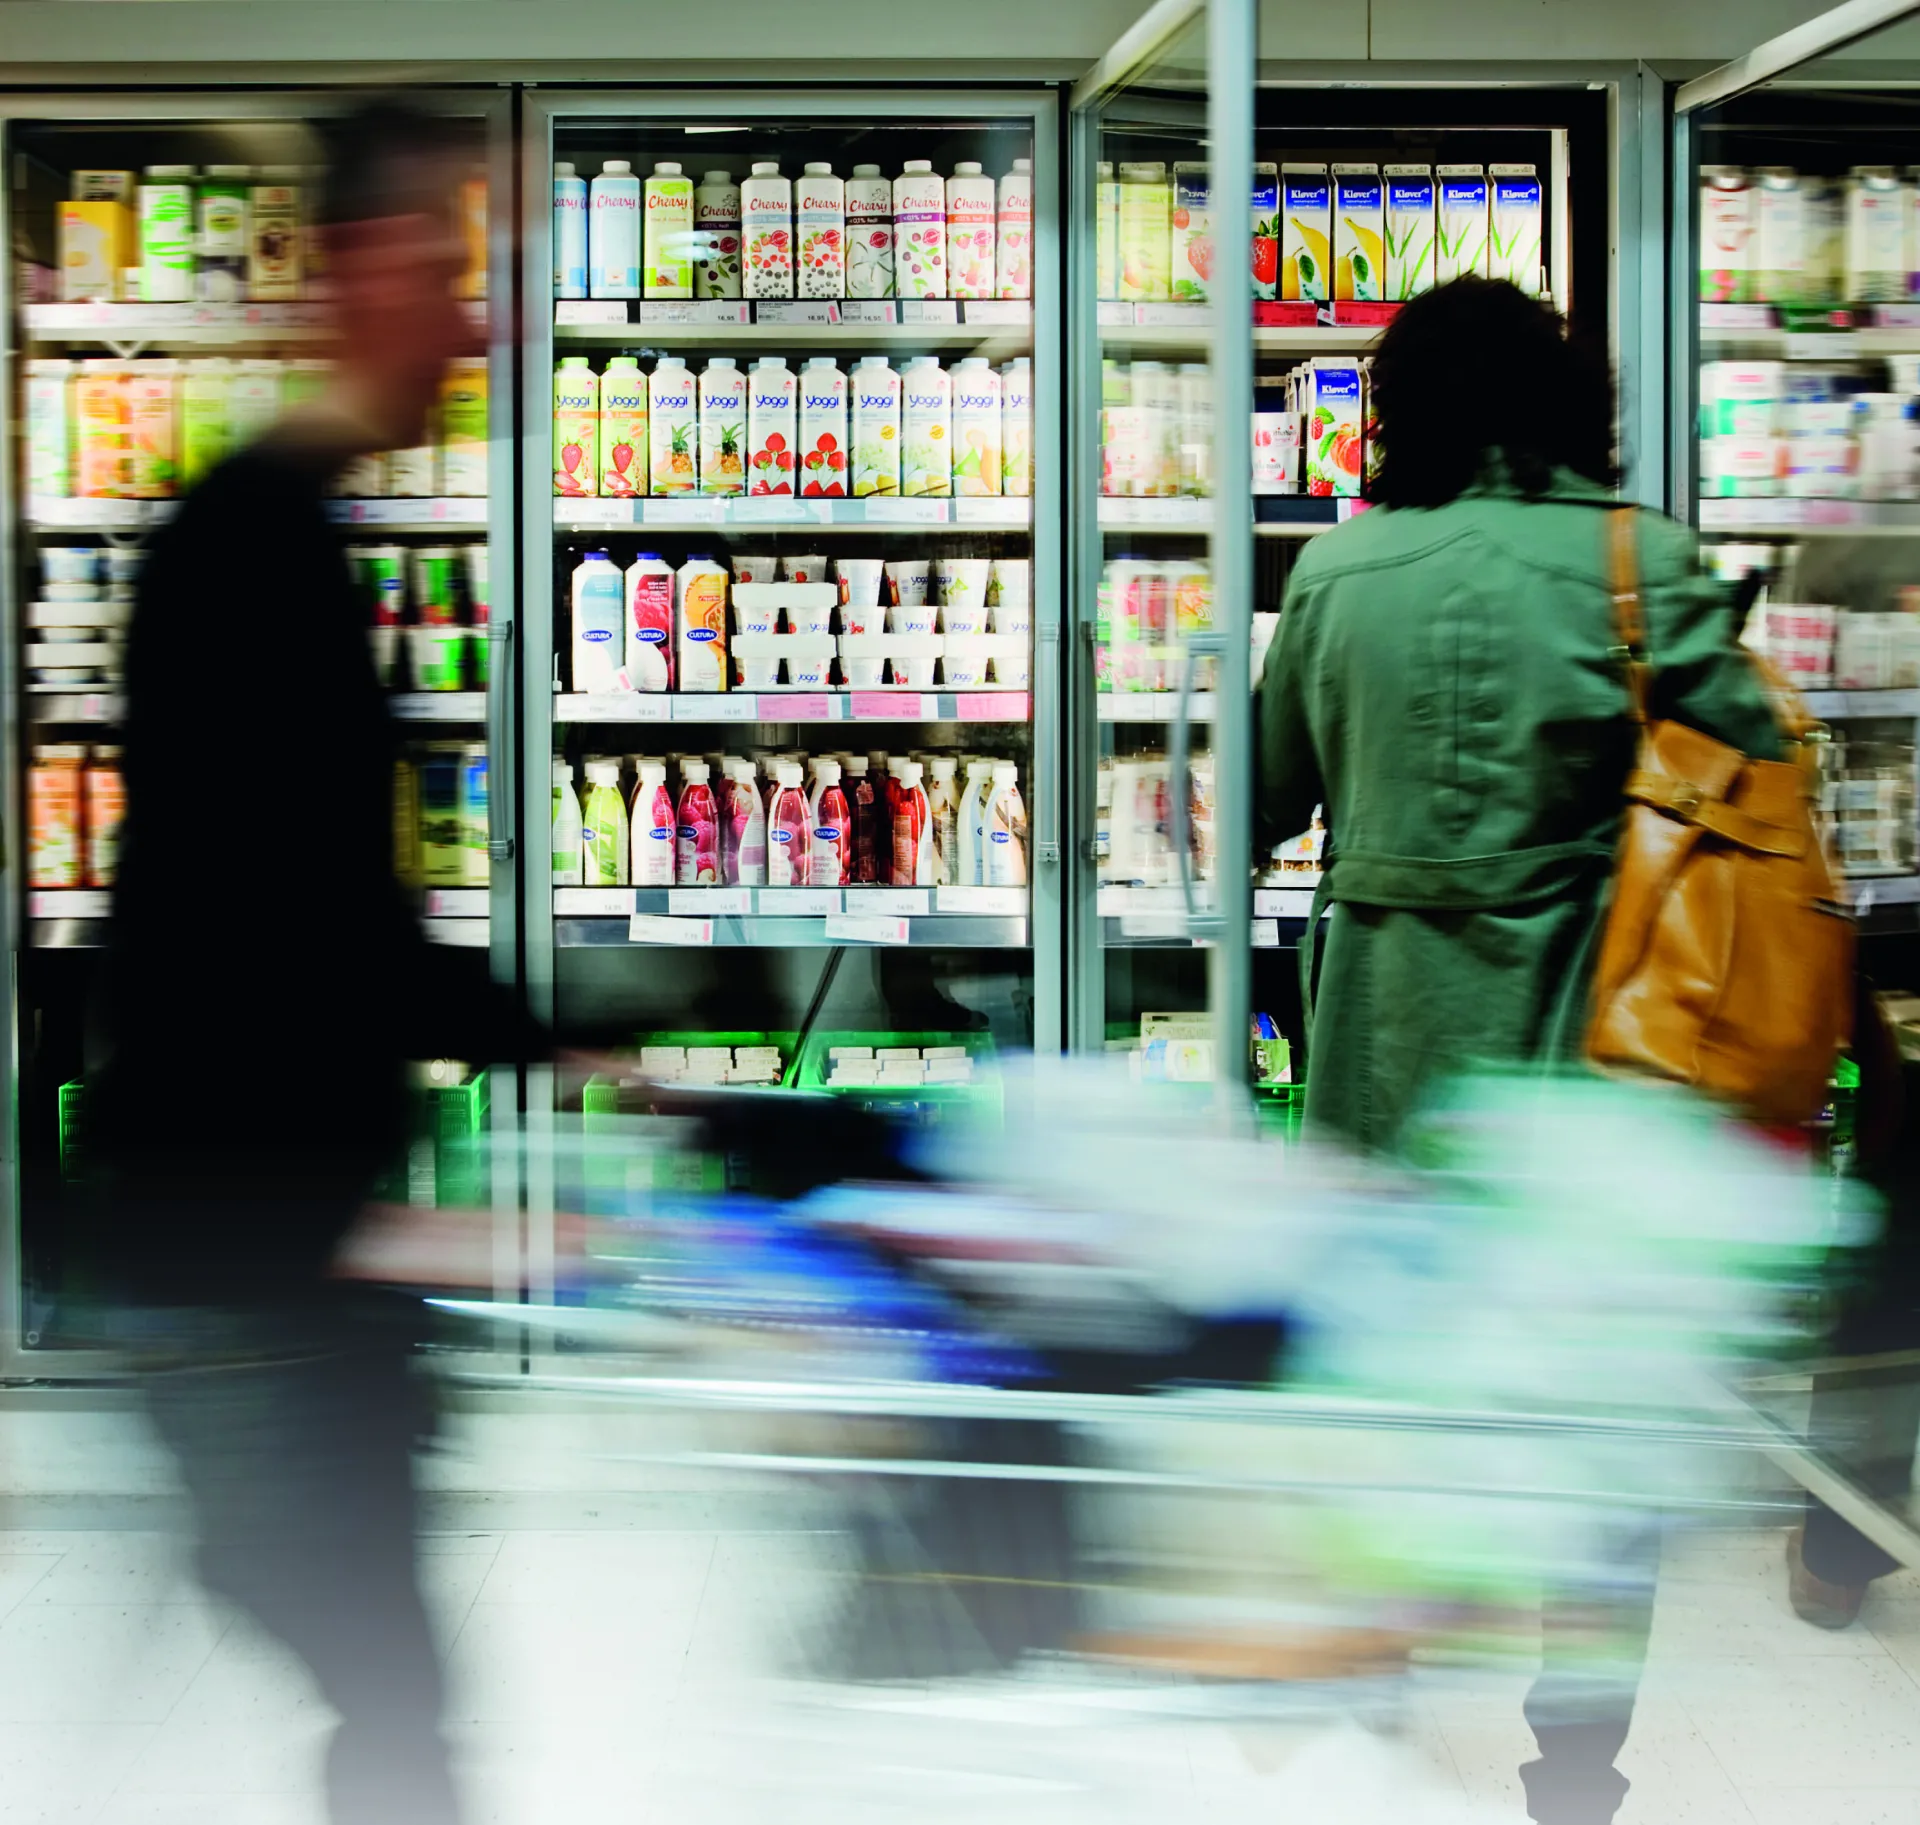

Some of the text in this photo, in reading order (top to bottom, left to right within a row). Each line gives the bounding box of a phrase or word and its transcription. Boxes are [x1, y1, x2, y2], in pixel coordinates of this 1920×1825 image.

[1290, 189, 1317, 198] Kløver
[1343, 189, 1370, 198] Kløver
[1394, 189, 1421, 198] Kløver
[1447, 189, 1474, 198] Kløver
[1501, 189, 1528, 198] Kløver
[554, 197, 578, 210] easy
[597, 194, 636, 210] Cheasy
[648, 195, 688, 211] Cheasy
[750, 198, 788, 212] Cheasy
[803, 197, 841, 212] Cheasy
[849, 199, 888, 213] Cheasy
[902, 196, 941, 211] Cheasy
[954, 197, 992, 211] Cheasy
[1006, 195, 1030, 208] Che
[700, 205, 738, 219] Cheasy
[1321, 384, 1349, 394] Kløver
